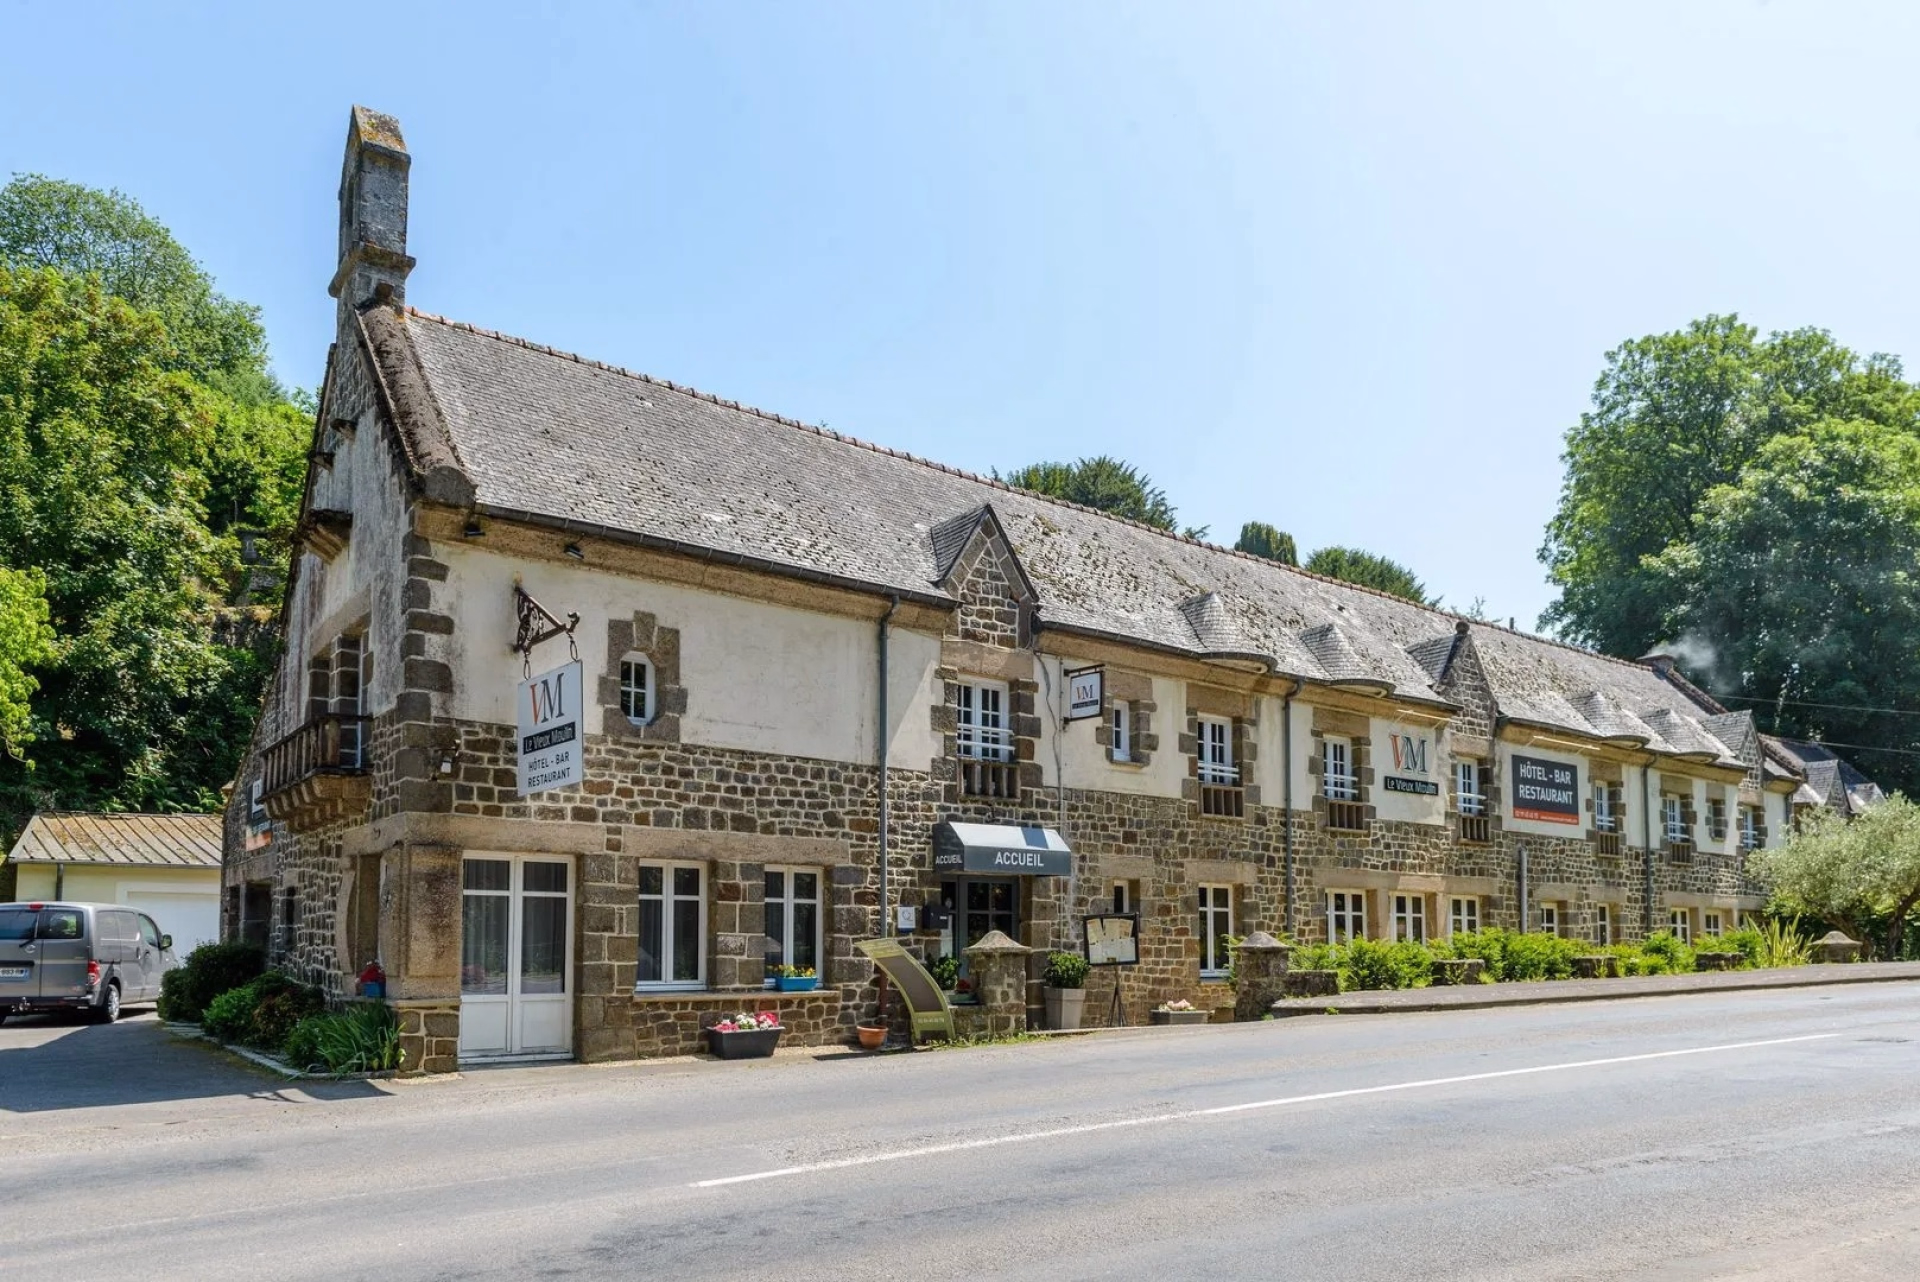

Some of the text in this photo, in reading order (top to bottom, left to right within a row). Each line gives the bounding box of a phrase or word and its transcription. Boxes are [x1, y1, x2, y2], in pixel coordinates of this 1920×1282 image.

[528, 757, 550, 772] HÔTEL
[555, 751, 570, 766] BAR
[527, 767, 571, 788] RESTAURANT
[1519, 760, 1548, 781] HÔTEL
[1553, 769, 1572, 785] BAR
[1519, 784, 1573, 805] RESTAURANT
[935, 853, 963, 865] ACCUEIL
[995, 851, 1045, 867] ACCUEIL
